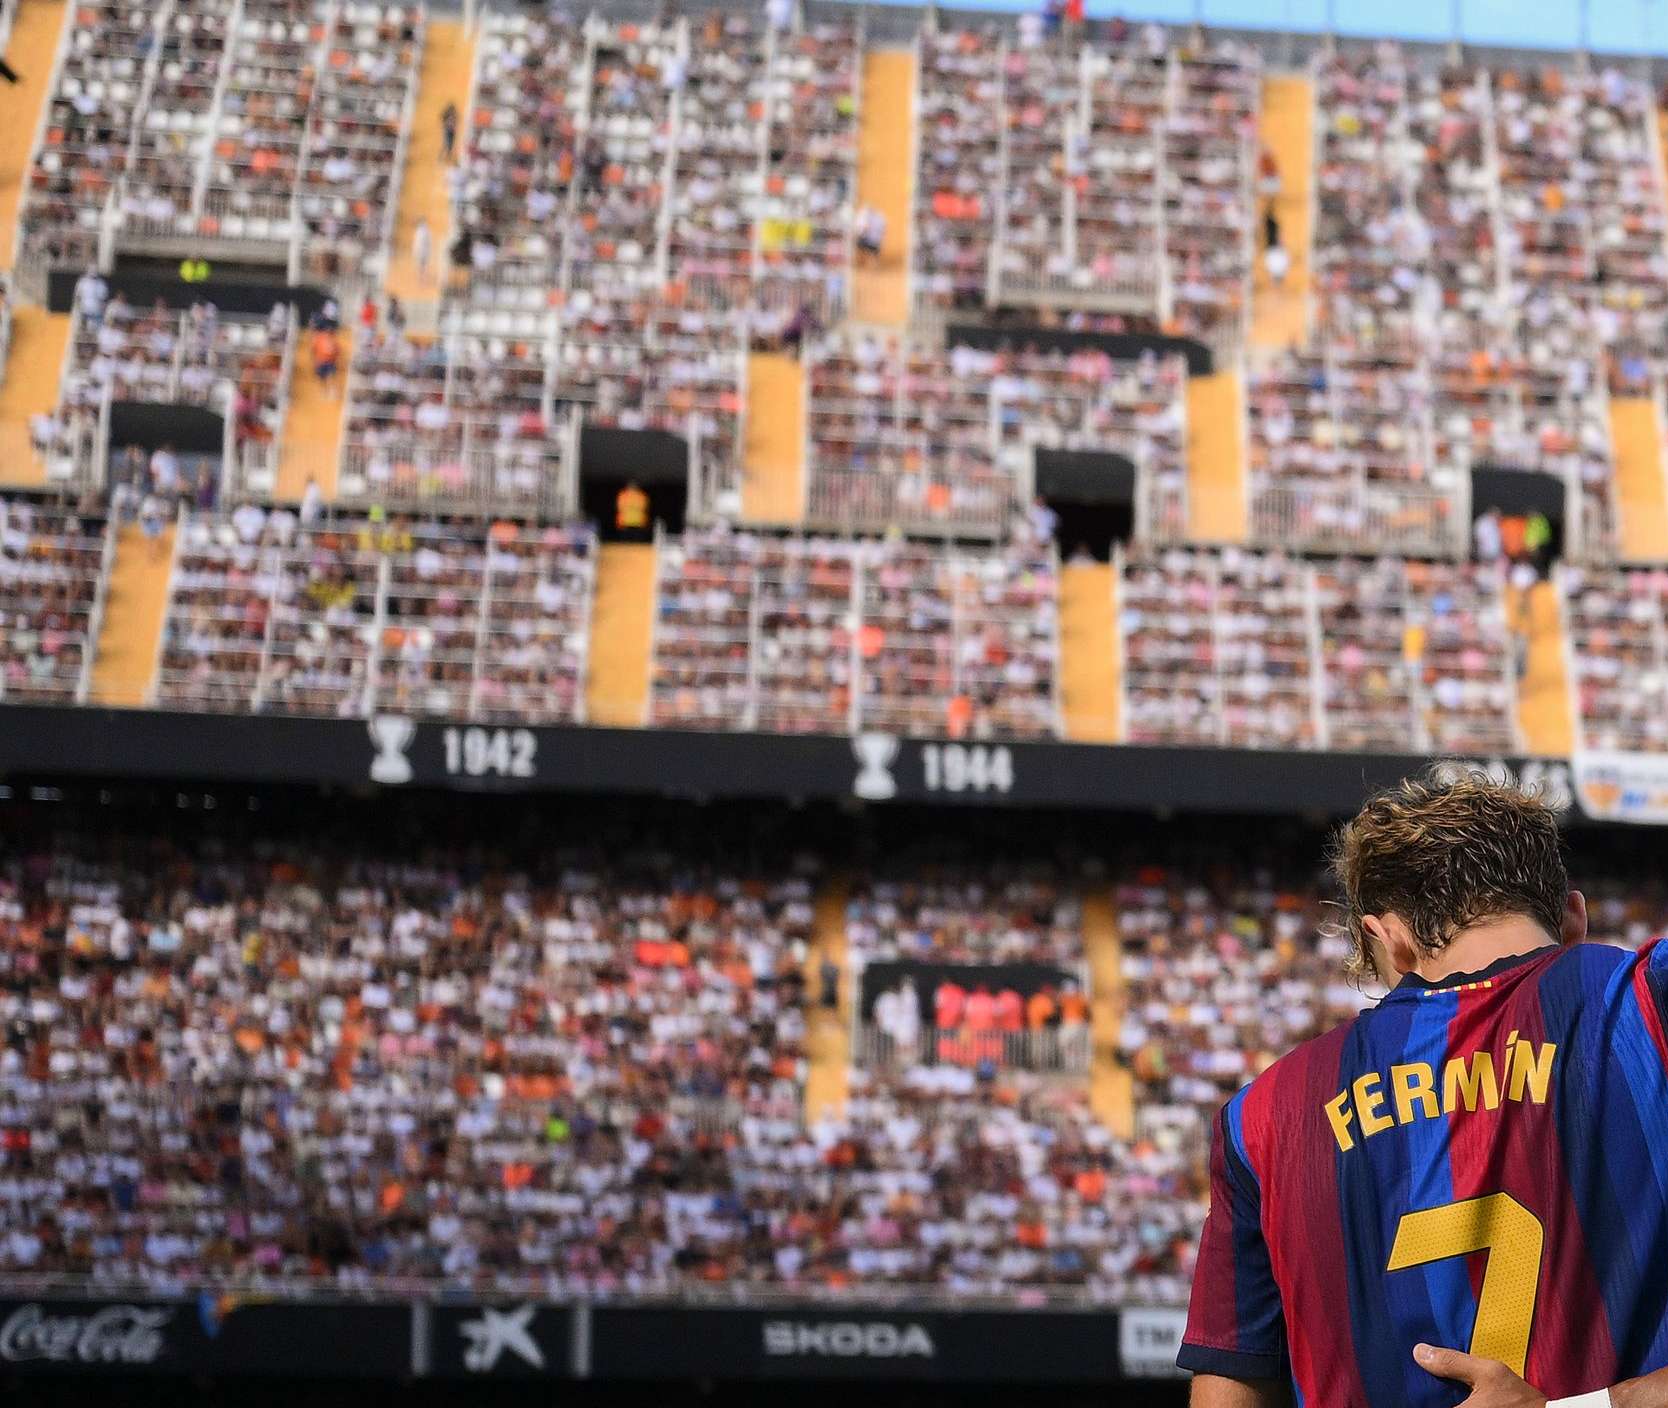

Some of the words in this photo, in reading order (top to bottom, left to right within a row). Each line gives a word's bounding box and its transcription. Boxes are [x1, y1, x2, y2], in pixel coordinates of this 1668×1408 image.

[444, 727, 537, 778] 1942
[921, 743, 1015, 792] 1944
[1324, 1029, 1558, 1152] FERMÍN
[1386, 1191, 1544, 1380] 7
